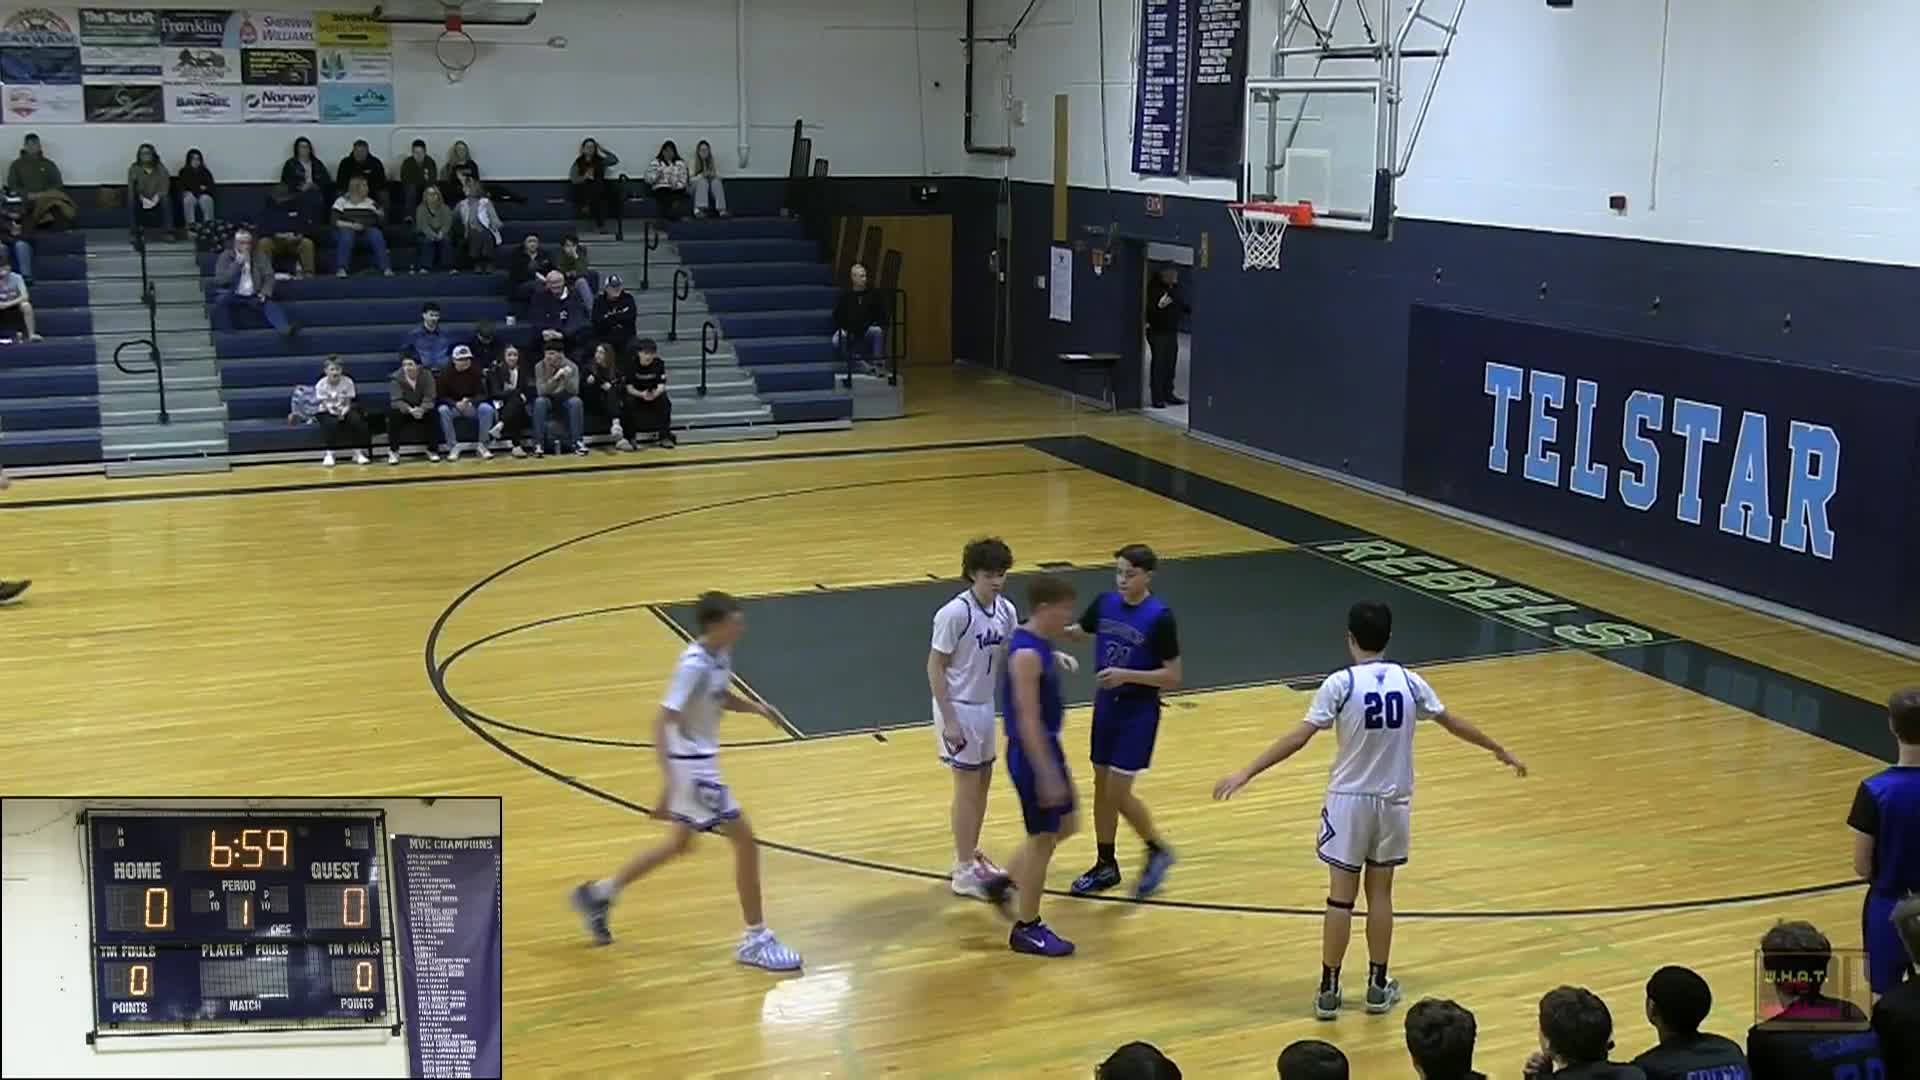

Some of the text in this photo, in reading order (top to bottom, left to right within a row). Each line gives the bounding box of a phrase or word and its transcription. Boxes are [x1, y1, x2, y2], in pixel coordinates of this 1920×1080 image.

[161, 18, 225, 32] Franklin
[262, 91, 316, 106] Norway
[1484, 361, 1840, 560] TELSTAR
[1318, 538, 1655, 647] REBELS
[1364, 690, 1404, 730] 20
[210, 829, 288, 869] 6:59
[409, 838, 493, 850] MVC CHAMPIONS
[113, 861, 162, 880] HOME
[222, 879, 256, 892] PERIOD
[145, 887, 168, 928] 0
[243, 899, 249, 926] 1
[343, 887, 365, 926] 0
[100, 945, 157, 958] TM FOULS
[201, 943, 289, 957] PLAYER FOULS
[328, 942, 380, 956] TM FOULS
[130, 965, 148, 995] 0
[356, 961, 372, 992] 0
[112, 1001, 148, 1013] POINTS
[229, 999, 262, 1012] MATCH
[340, 998, 374, 1010] POINTS
